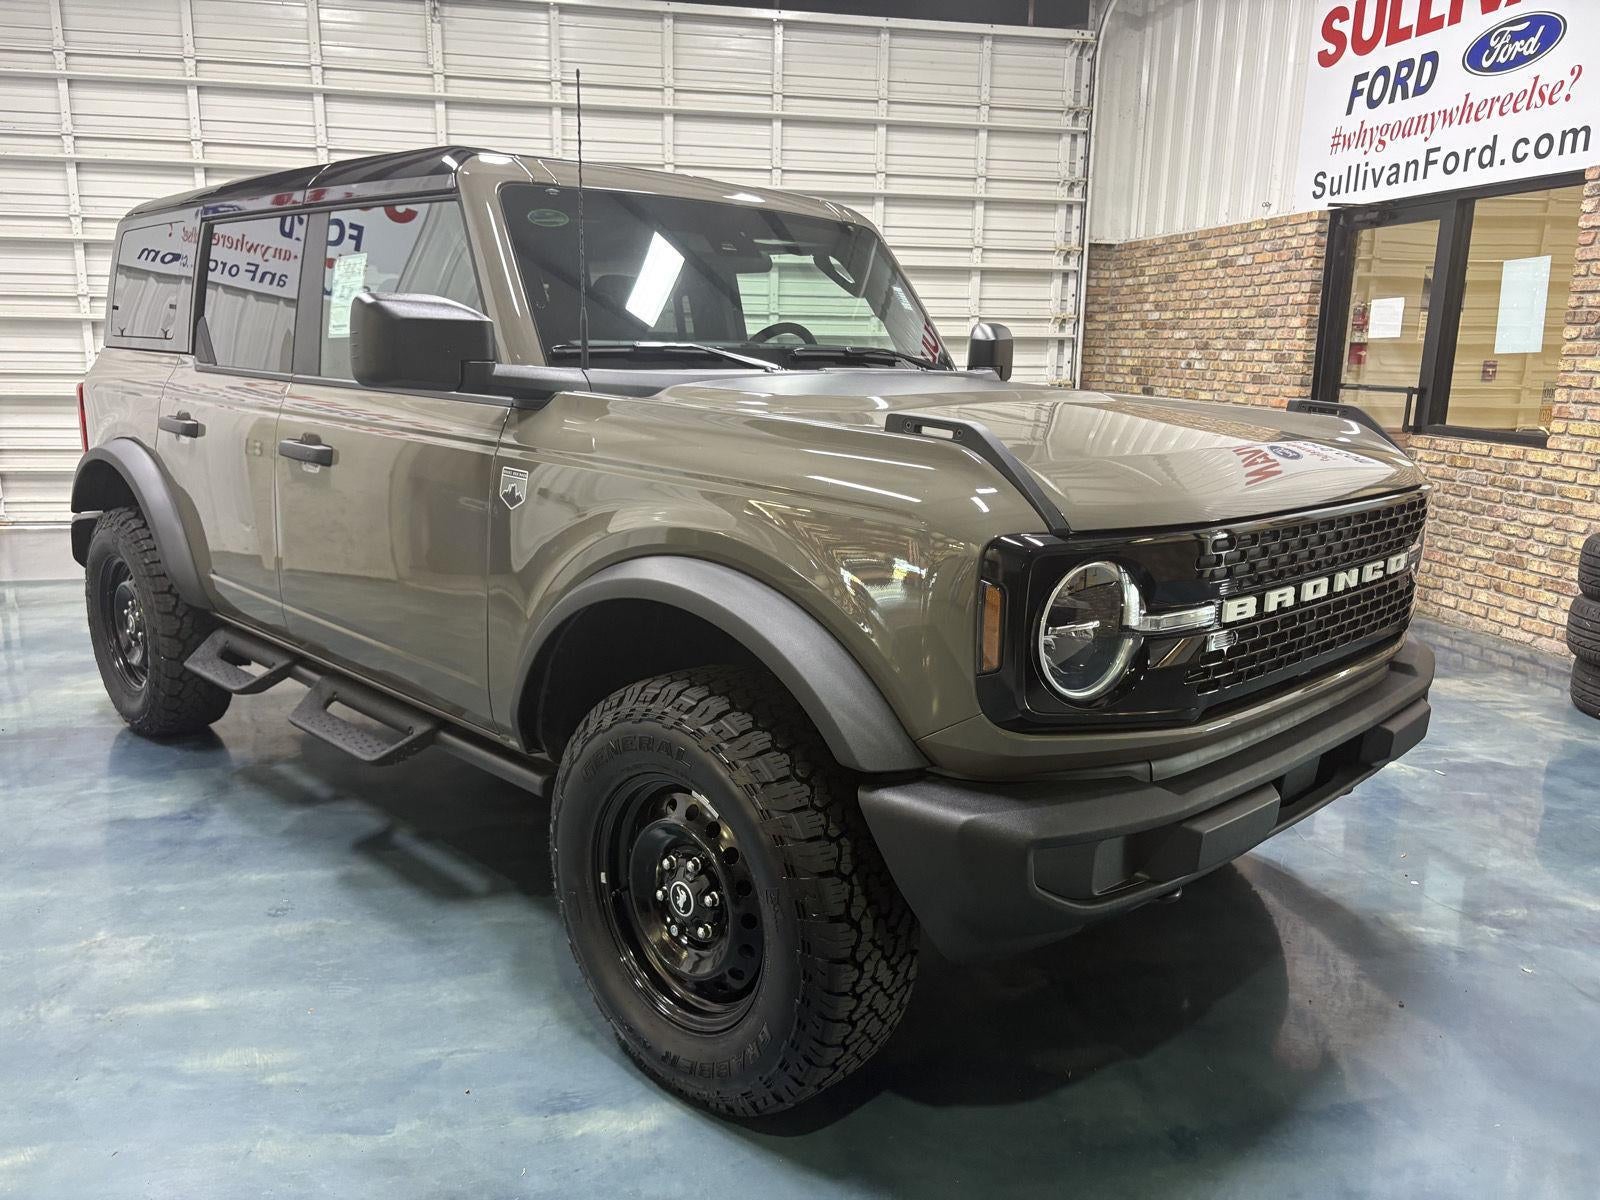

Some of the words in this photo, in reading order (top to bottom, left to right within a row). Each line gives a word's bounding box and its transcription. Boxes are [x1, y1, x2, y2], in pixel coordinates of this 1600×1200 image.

[1482, 21, 1545, 68] Ford
[1330, 64, 1583, 156] #whygoanywhereelse?
[1345, 50, 1440, 116] FORD
[1312, 125, 1592, 200] SullivanFord.com
[1221, 553, 1409, 623] BRONCO
